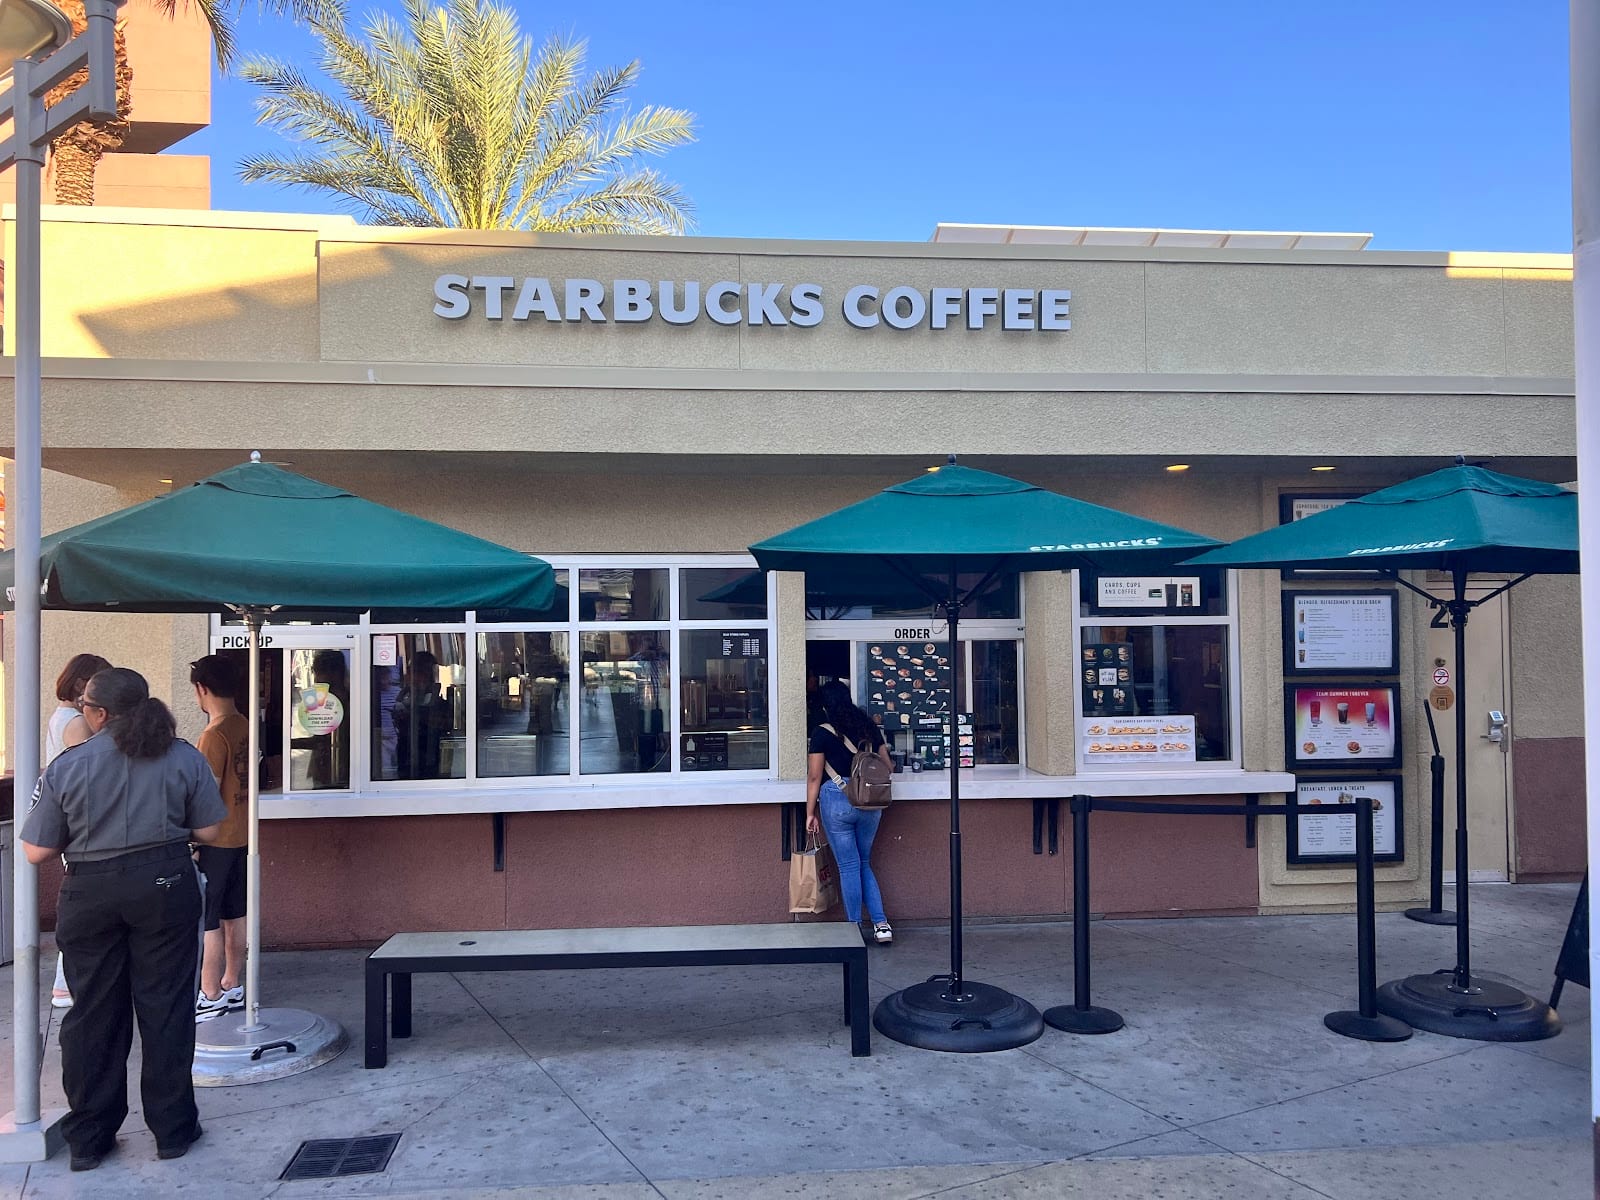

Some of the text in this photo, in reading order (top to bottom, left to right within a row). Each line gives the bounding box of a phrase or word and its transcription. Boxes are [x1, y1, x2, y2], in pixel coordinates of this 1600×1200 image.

[433, 274, 1072, 331] STARBUCKS COFFEE
[894, 628, 930, 639] ORDER
[222, 636, 250, 648] PICK
